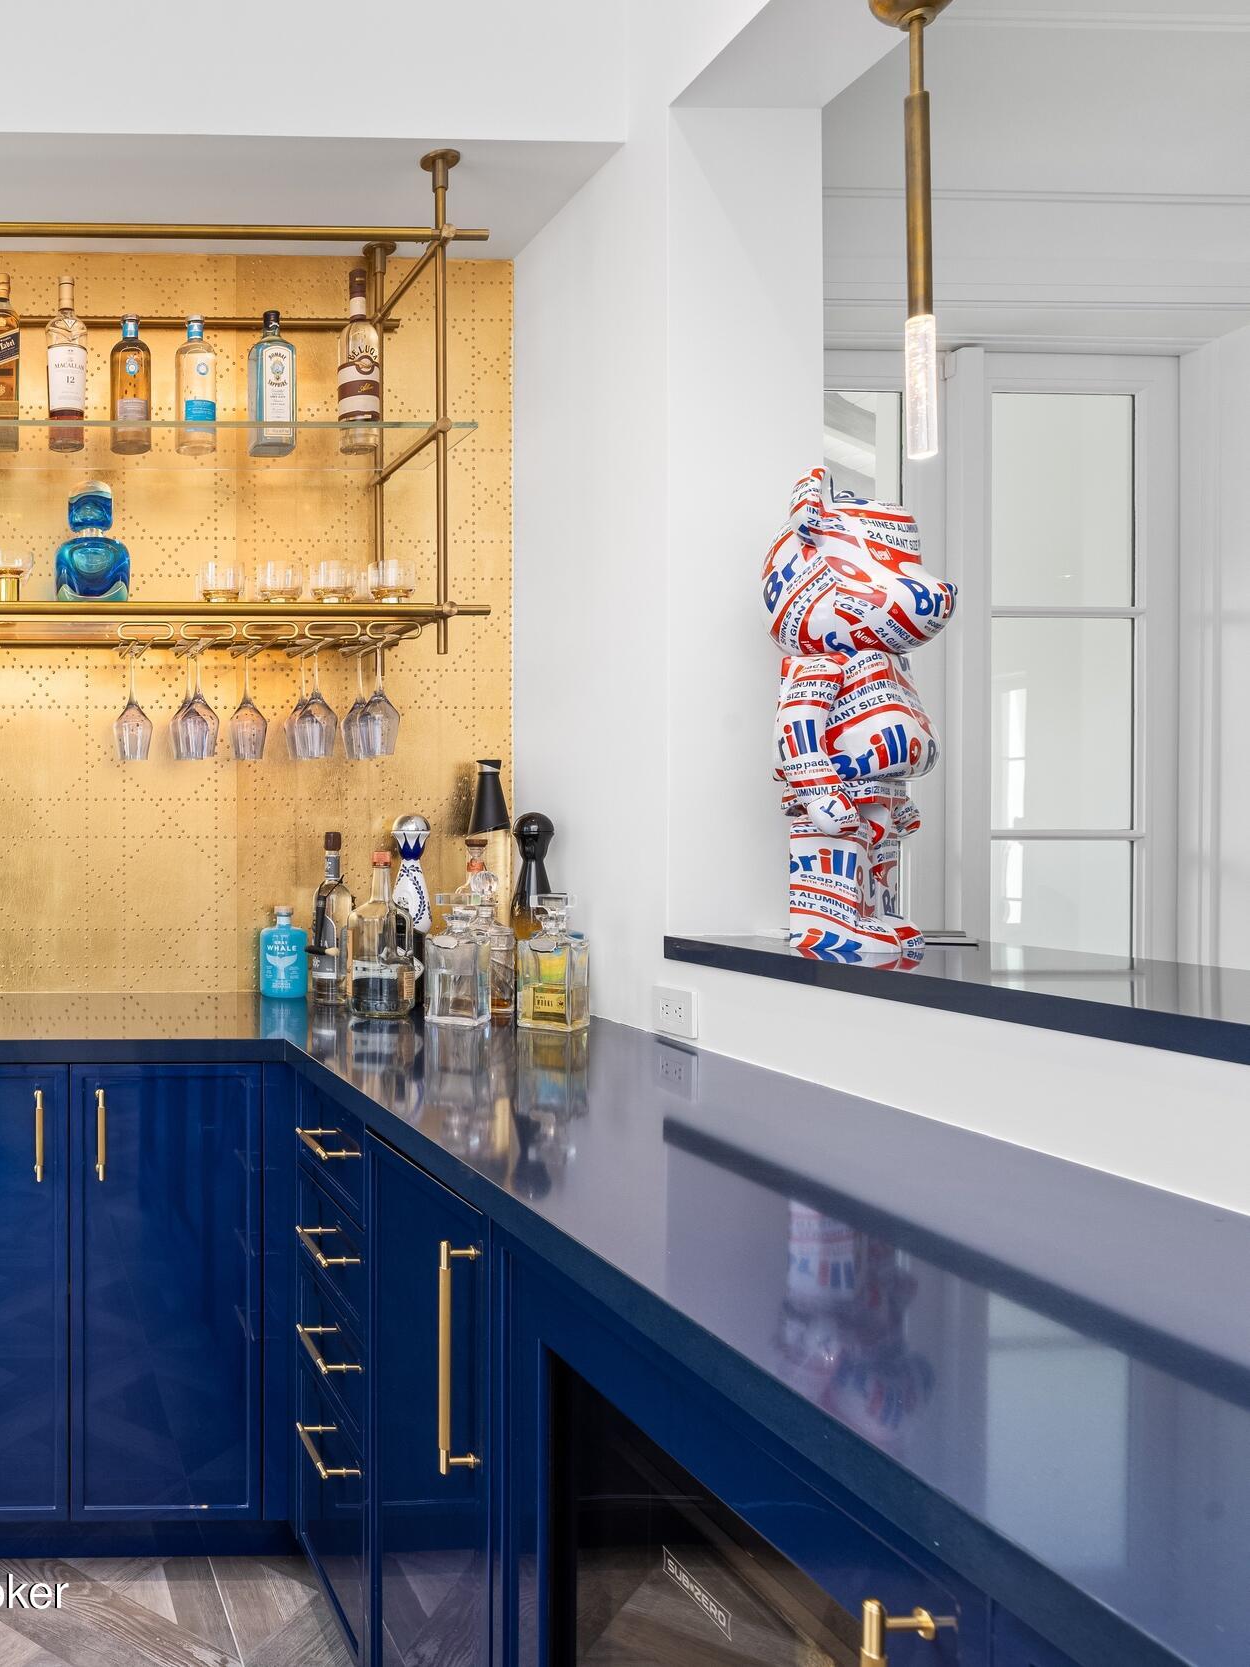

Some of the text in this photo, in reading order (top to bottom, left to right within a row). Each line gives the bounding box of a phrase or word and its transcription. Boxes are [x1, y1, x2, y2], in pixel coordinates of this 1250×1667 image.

[348, 345, 377, 360] BELUGA
[54, 362, 84, 371] MACALLAN
[66, 375, 75, 383] 12
[860, 518, 896, 530] SHINES
[867, 530, 883, 541] 24
[886, 535, 909, 549] GIANT
[854, 630, 879, 646] New!
[875, 627, 888, 638] 24
[886, 619, 910, 642] SHINES
[858, 652, 883, 669] pads
[787, 691, 807, 701] SIZE
[838, 680, 888, 709] ALUMINUM
[859, 695, 886, 710] SIZE
[830, 724, 922, 780] Brillo
[804, 759, 829, 770] pads
[800, 873, 833, 884] soap
[820, 905, 851, 923] SIZE
